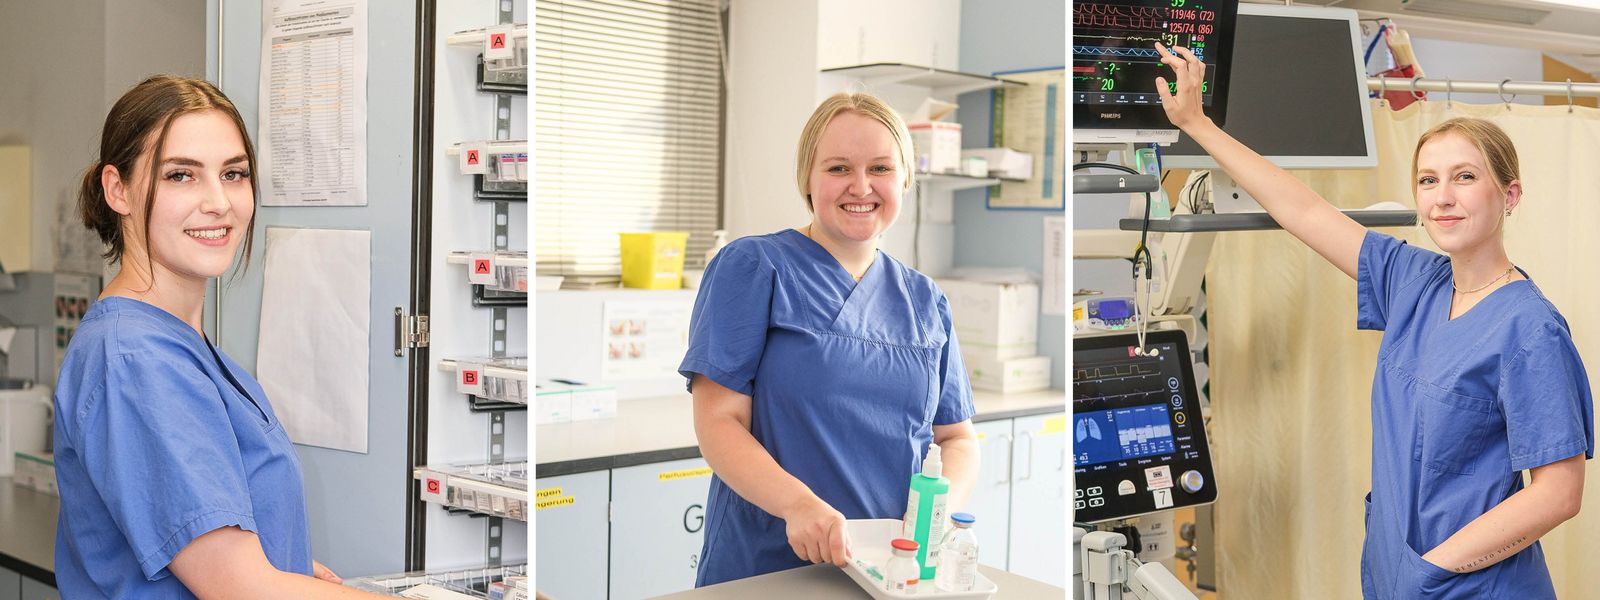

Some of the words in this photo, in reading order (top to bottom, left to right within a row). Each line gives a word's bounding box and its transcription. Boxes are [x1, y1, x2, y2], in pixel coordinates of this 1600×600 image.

[1171, 9, 1196, 20] 119/46
[1199, 10, 1215, 21] (72)
[1169, 22, 1195, 34] 125/74
[1198, 23, 1214, 34] (86)
[494, 36, 504, 47] A
[1166, 34, 1179, 46] 31
[1101, 78, 1115, 91] 20
[467, 152, 478, 163] A
[477, 261, 488, 272] A
[465, 372, 475, 383] B
[428, 481, 438, 492] C
[1158, 490, 1166, 506] 7
[684, 505, 704, 533] G
[1454, 553, 1495, 573] MEMENTO
[1498, 536, 1527, 554] VIVERE
